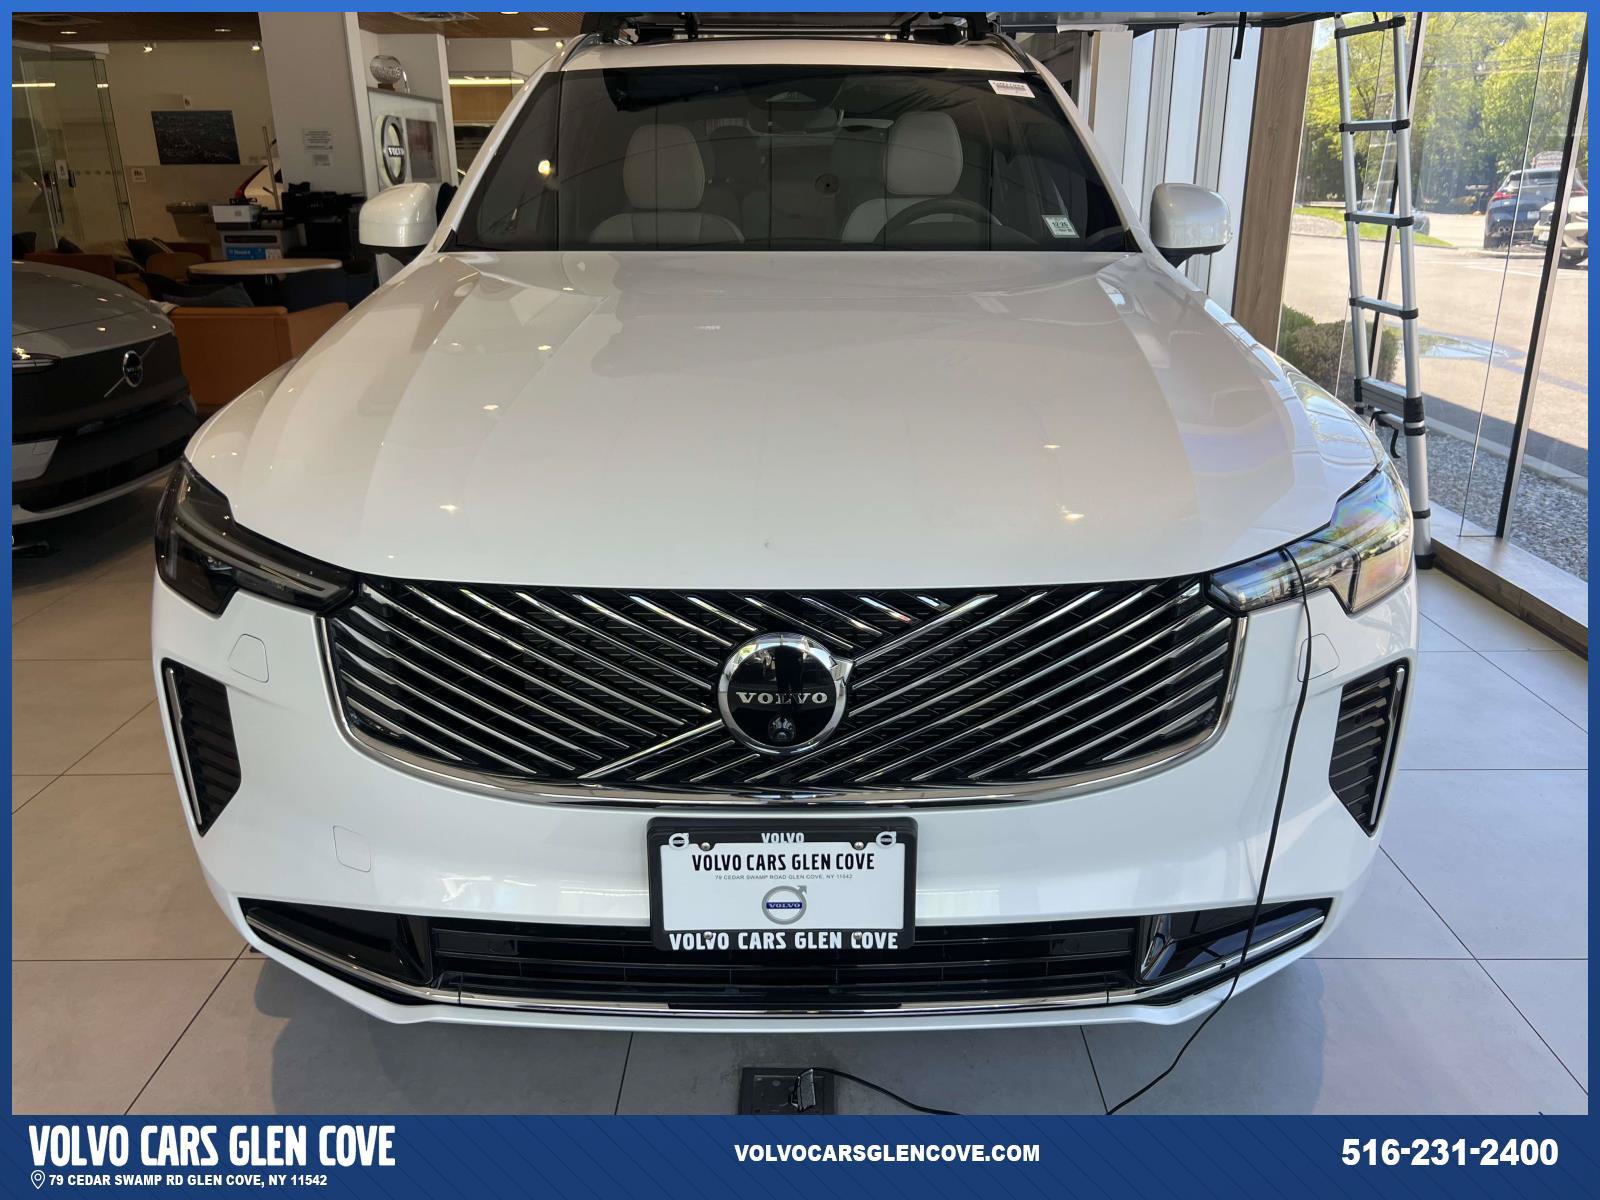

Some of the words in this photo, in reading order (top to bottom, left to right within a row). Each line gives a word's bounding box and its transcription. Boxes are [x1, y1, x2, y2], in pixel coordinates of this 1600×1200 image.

[736, 692, 828, 705] VOLVO
[761, 832, 804, 843] VOLVO
[692, 854, 742, 872] VOLVO
[746, 854, 786, 871] CARS
[791, 854, 831, 871] GLEN
[836, 853, 875, 870] COVE
[668, 931, 730, 951] VOLVO
[738, 931, 787, 950] CARS
[794, 931, 842, 950] GLEN
[850, 931, 898, 949] COVE
